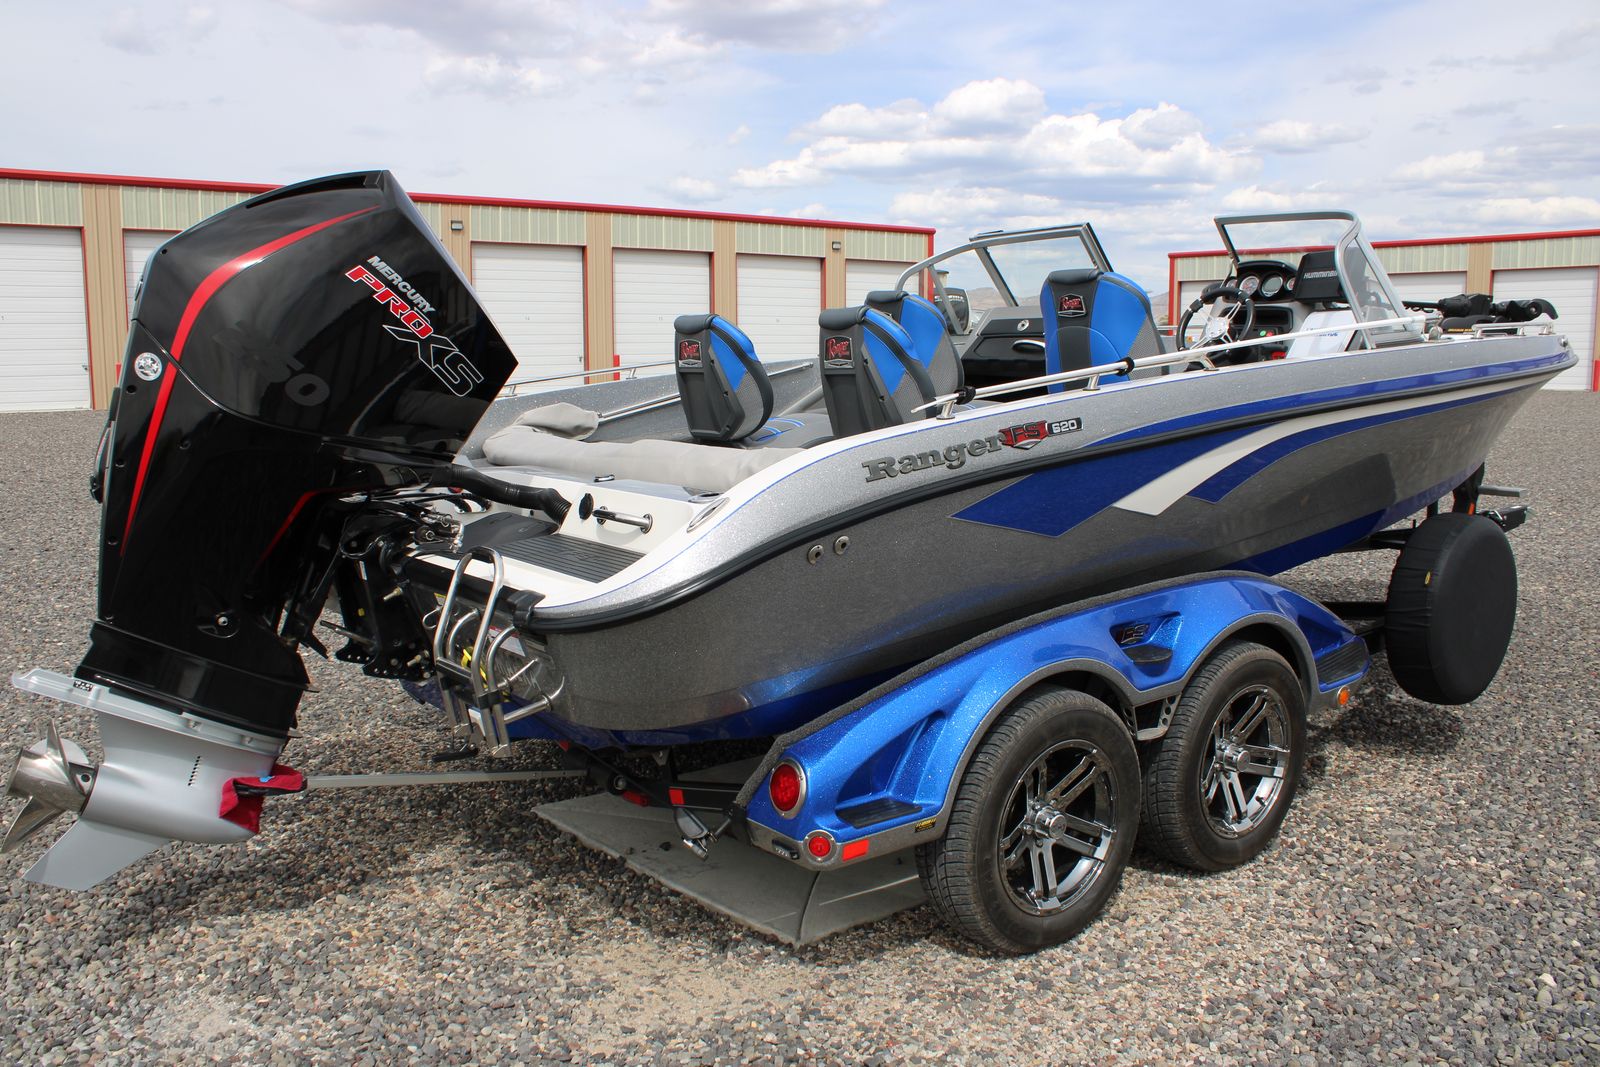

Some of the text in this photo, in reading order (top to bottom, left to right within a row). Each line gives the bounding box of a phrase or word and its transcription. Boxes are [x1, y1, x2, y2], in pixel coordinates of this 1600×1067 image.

[367, 255, 436, 313] MERCURY
[345, 264, 484, 397] PRO XS
[862, 433, 1005, 482] Ranger
[1052, 418, 1078, 434] 620
